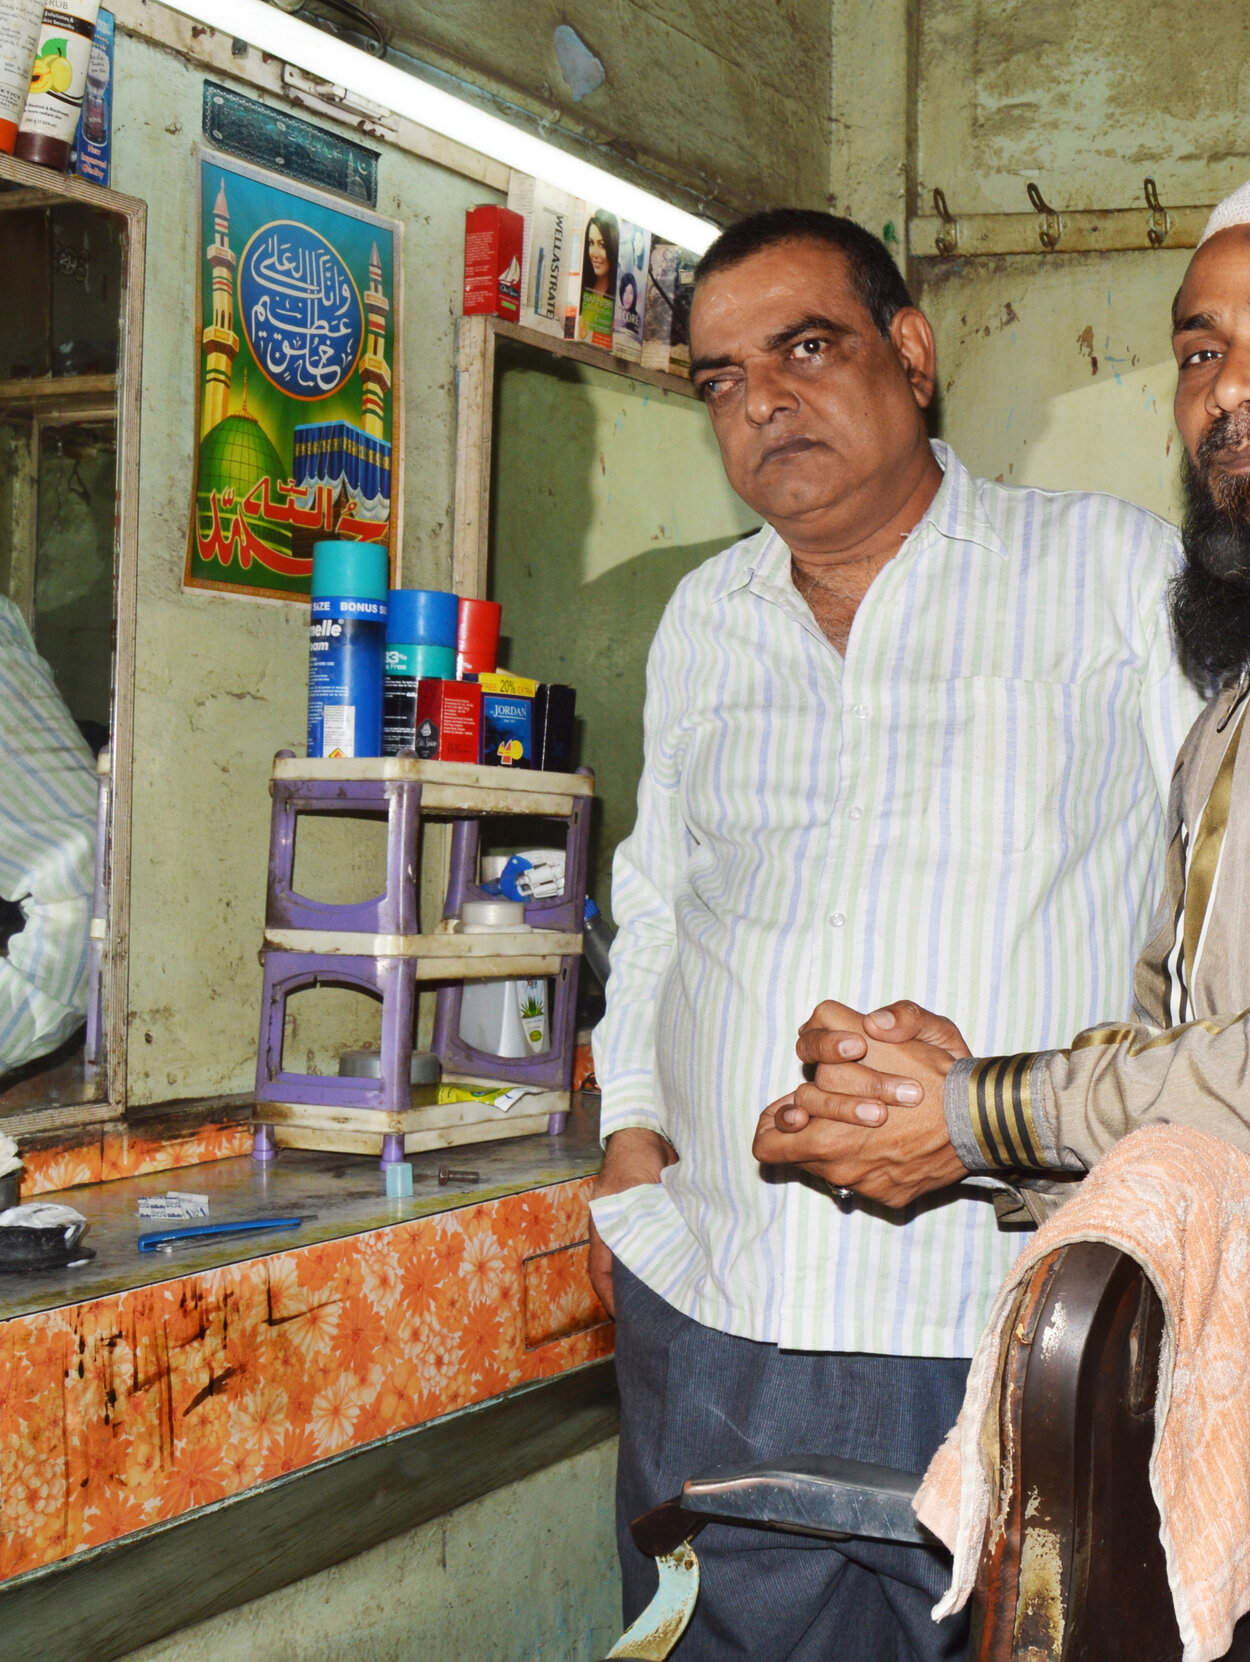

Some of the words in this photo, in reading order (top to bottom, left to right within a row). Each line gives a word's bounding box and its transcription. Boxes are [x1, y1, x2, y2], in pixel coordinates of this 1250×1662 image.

[546, 215, 565, 321] WELLASTRATE
[340, 602, 378, 614] BONUS
[500, 680, 516, 694] 20%
[493, 704, 527, 717] JORDAN
